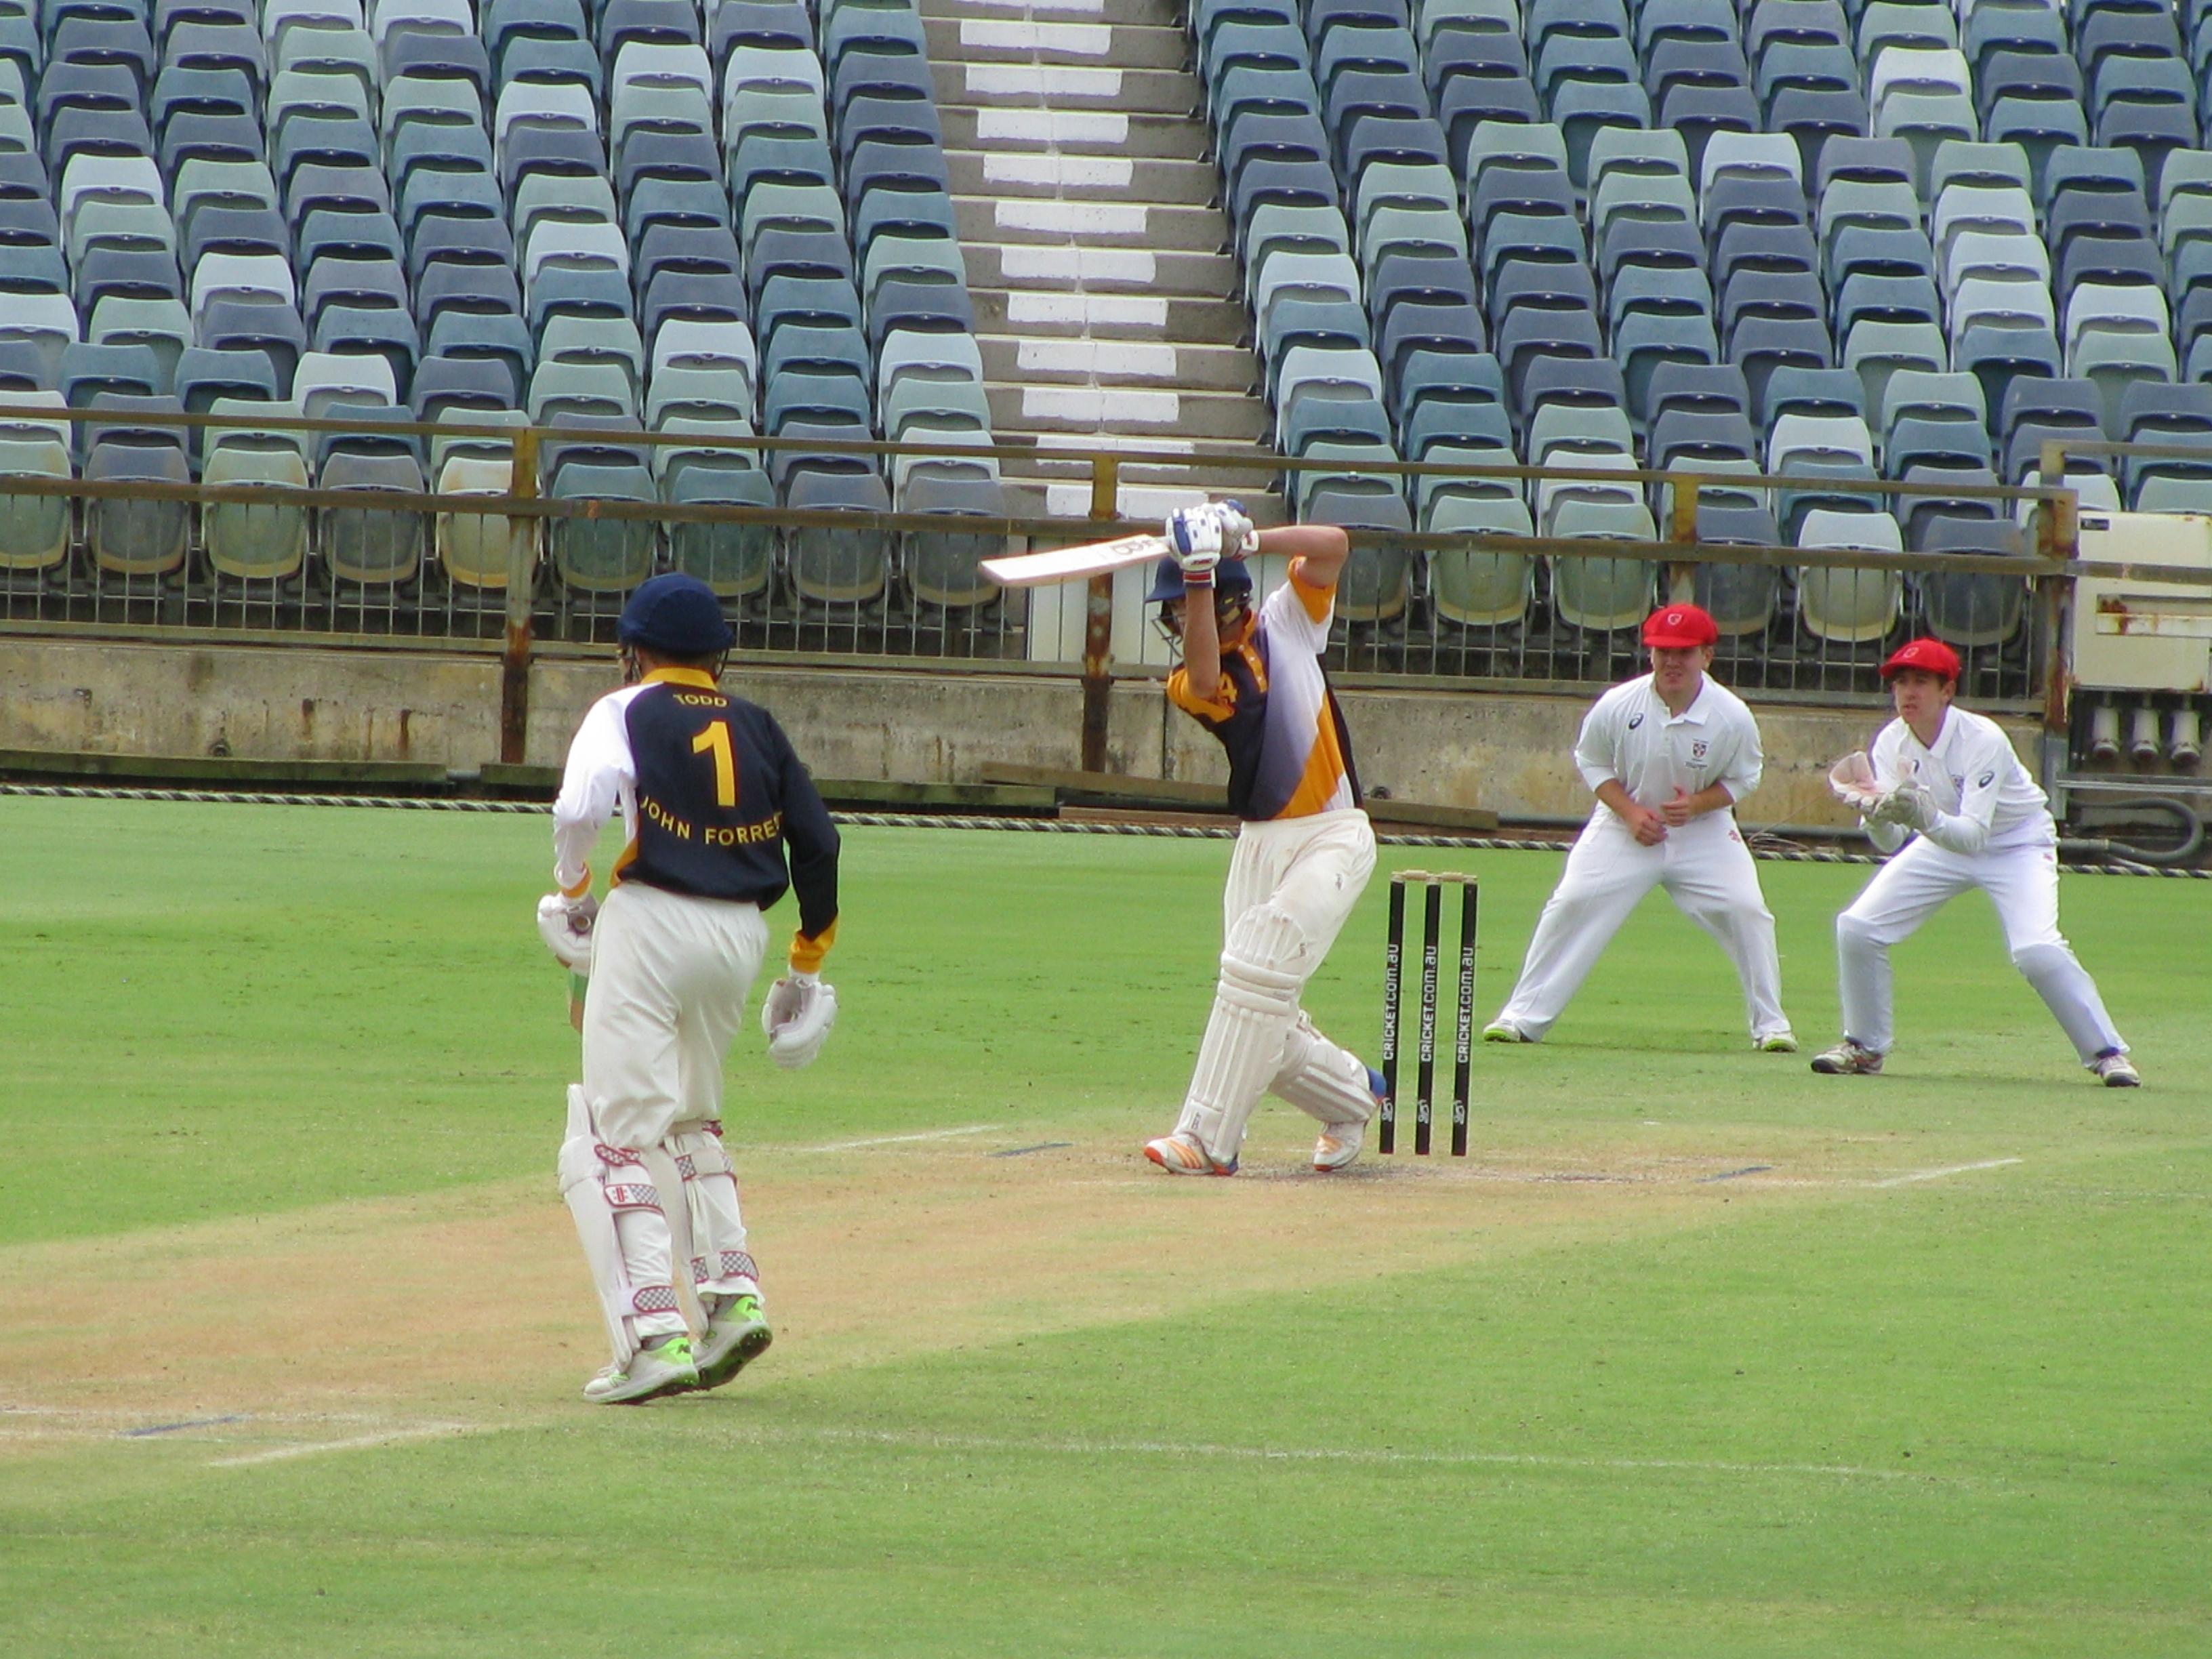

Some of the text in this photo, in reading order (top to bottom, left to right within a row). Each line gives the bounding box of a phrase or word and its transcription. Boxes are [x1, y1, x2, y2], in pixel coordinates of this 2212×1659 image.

[672, 693, 728, 708] TODD
[692, 721, 735, 807] 1
[640, 796, 691, 840] JOHN
